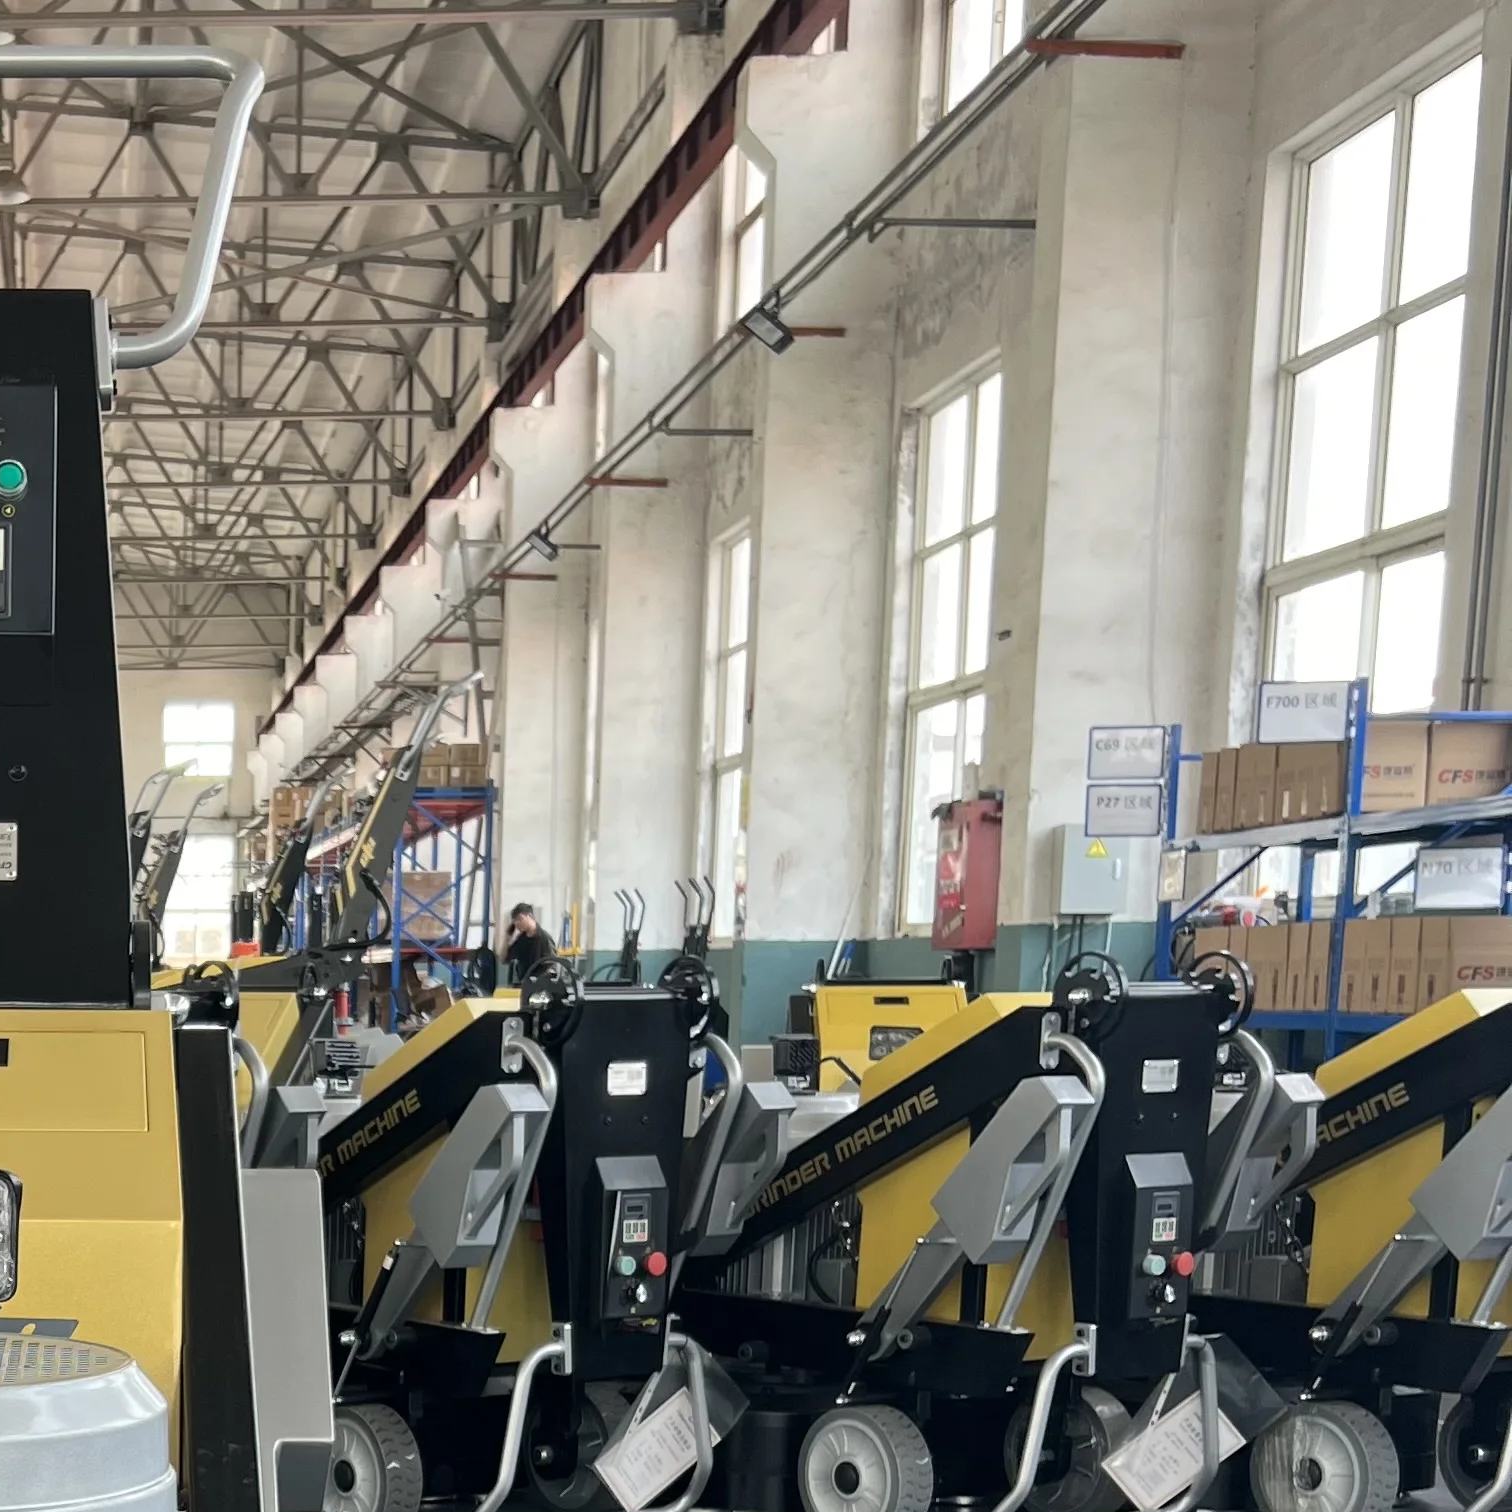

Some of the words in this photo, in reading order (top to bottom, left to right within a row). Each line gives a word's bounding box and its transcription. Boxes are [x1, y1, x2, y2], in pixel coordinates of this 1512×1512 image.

[1266, 695, 1300, 709] F700
[1438, 769, 1474, 784] CFS
[1096, 796, 1120, 809] P27
[1457, 965, 1495, 981] CFS
[1316, 1081, 1410, 1148] ACHINE
[336, 1088, 421, 1165] MACHINE
[834, 1085, 939, 1163] MACHINE
